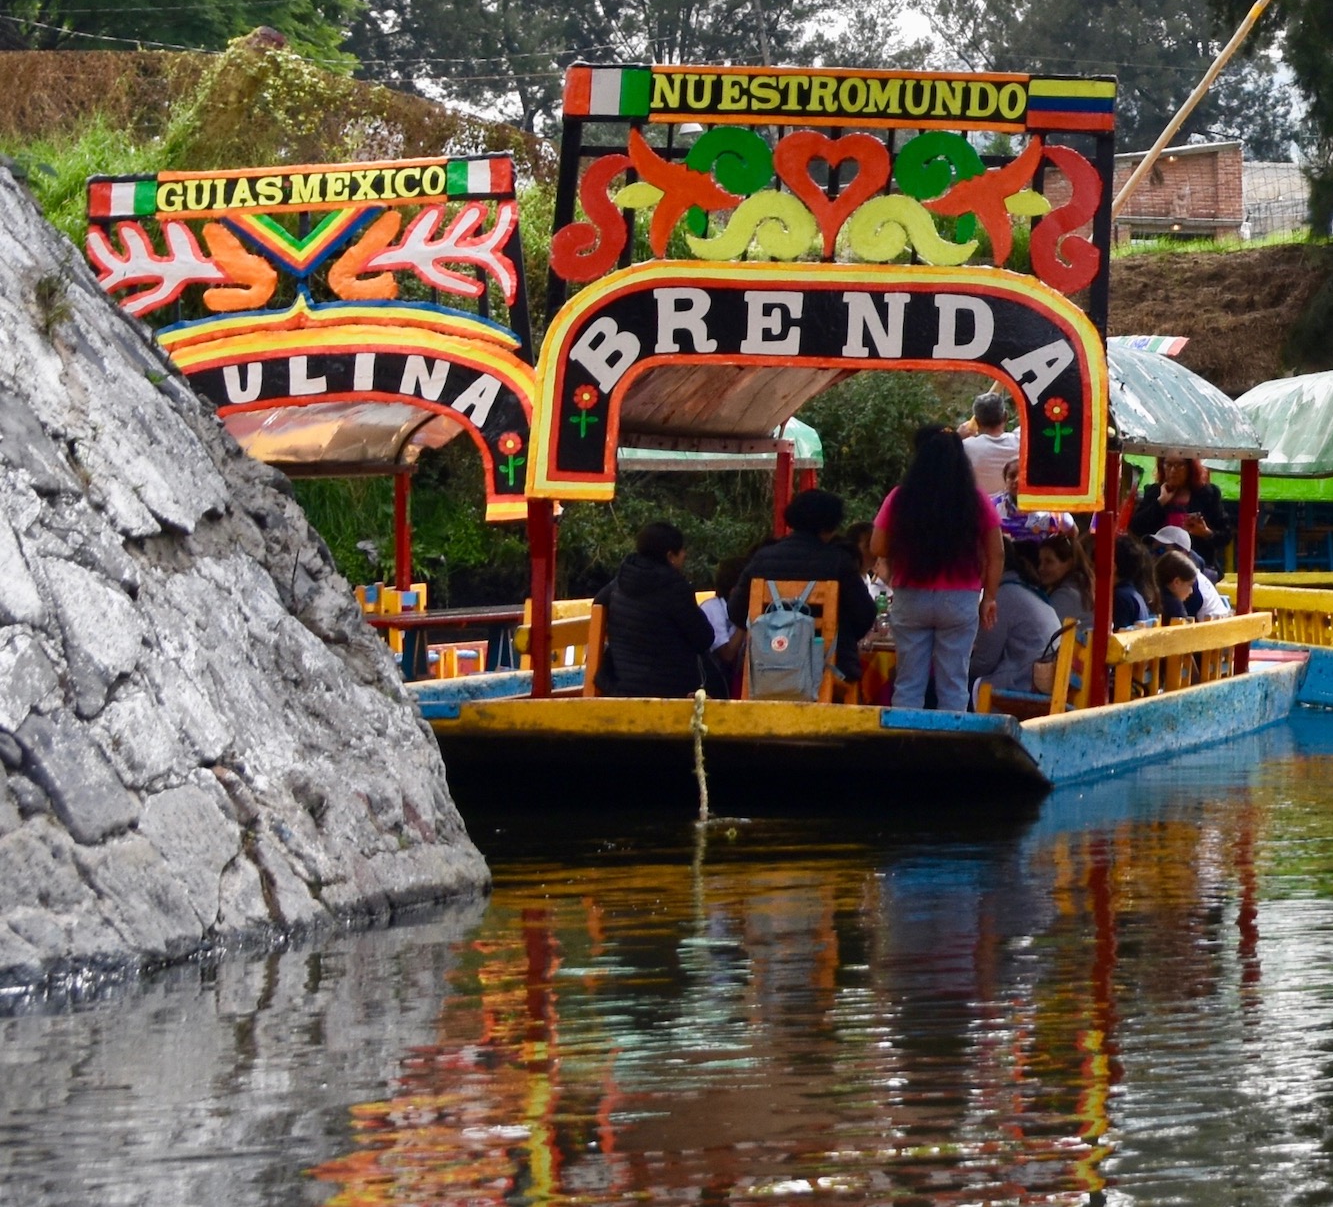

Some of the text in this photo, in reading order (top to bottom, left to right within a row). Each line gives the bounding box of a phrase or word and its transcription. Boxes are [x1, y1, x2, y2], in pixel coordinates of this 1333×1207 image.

[156, 166, 446, 212] GUIAS MEXICO
[569, 287, 1075, 405] BRENDA
[222, 353, 502, 428] ULINA
